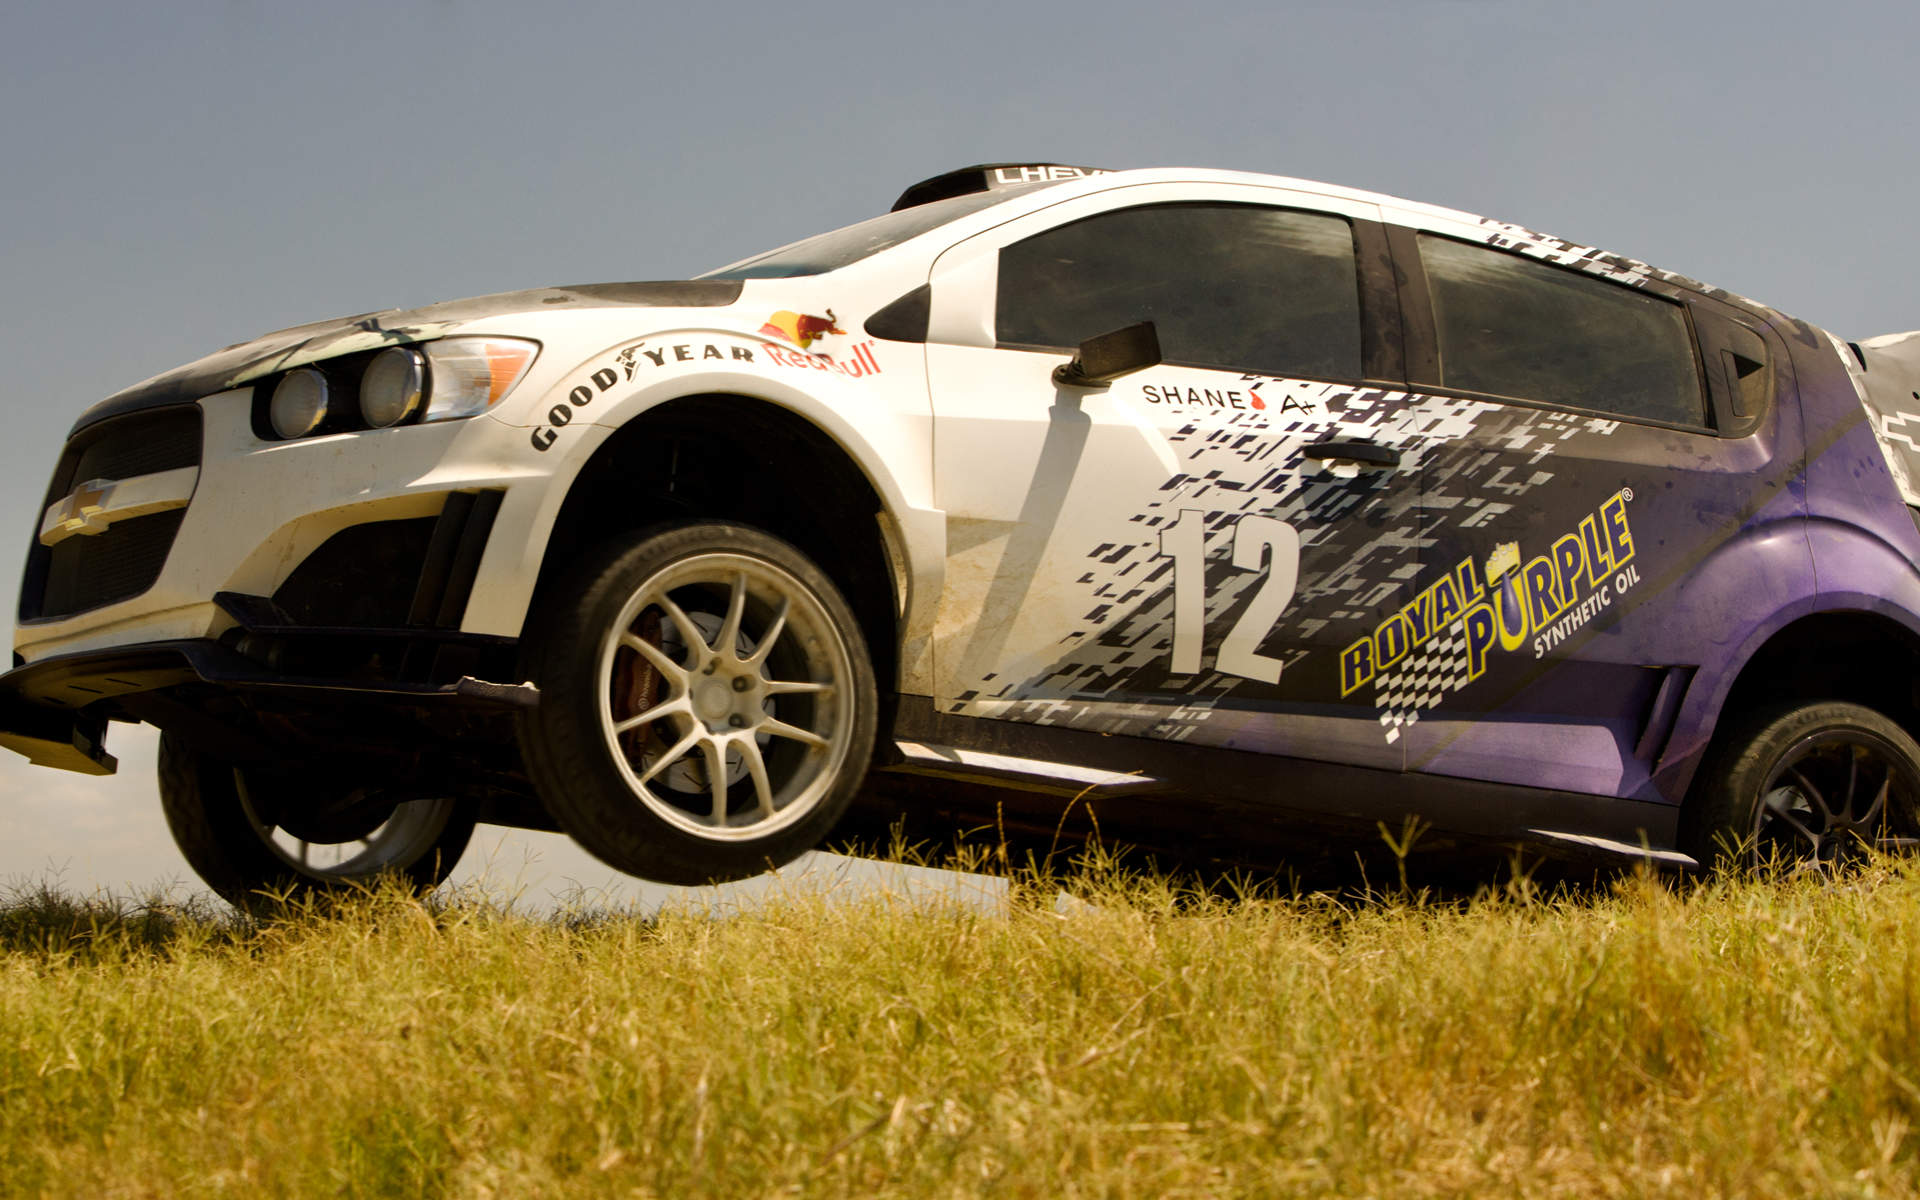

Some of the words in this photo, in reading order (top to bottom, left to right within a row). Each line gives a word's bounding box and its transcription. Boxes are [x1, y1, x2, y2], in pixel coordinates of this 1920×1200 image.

[531, 343, 754, 452] GOODYEAR
[1142, 385, 1247, 410] SHANE
[1160, 508, 1300, 685] 12
[1340, 555, 1486, 699] ROYAL
[1534, 588, 1612, 660] SYNTHETIC
[1615, 564, 1641, 595] OIL
